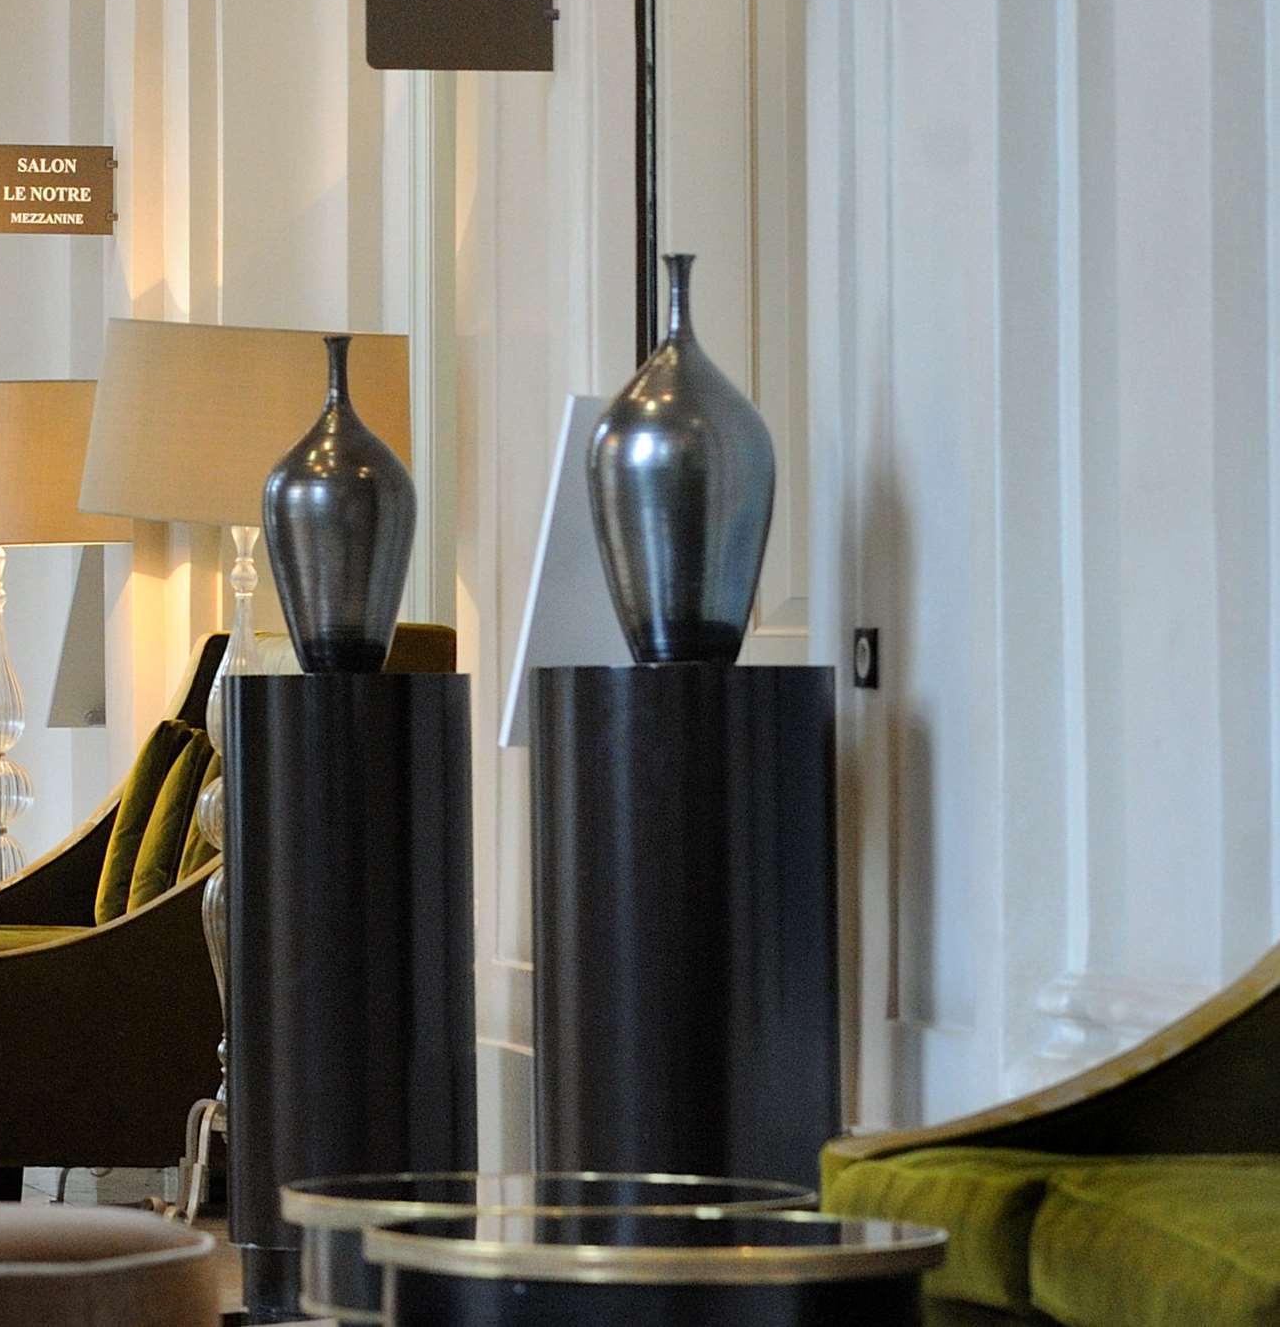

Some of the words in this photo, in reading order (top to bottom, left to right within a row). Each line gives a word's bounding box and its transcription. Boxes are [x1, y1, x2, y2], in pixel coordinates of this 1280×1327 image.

[16, 157, 78, 174] SALON
[3, 185, 27, 202] LE
[30, 186, 92, 203] NOTRE
[10, 212, 84, 225] MEZZANINE
